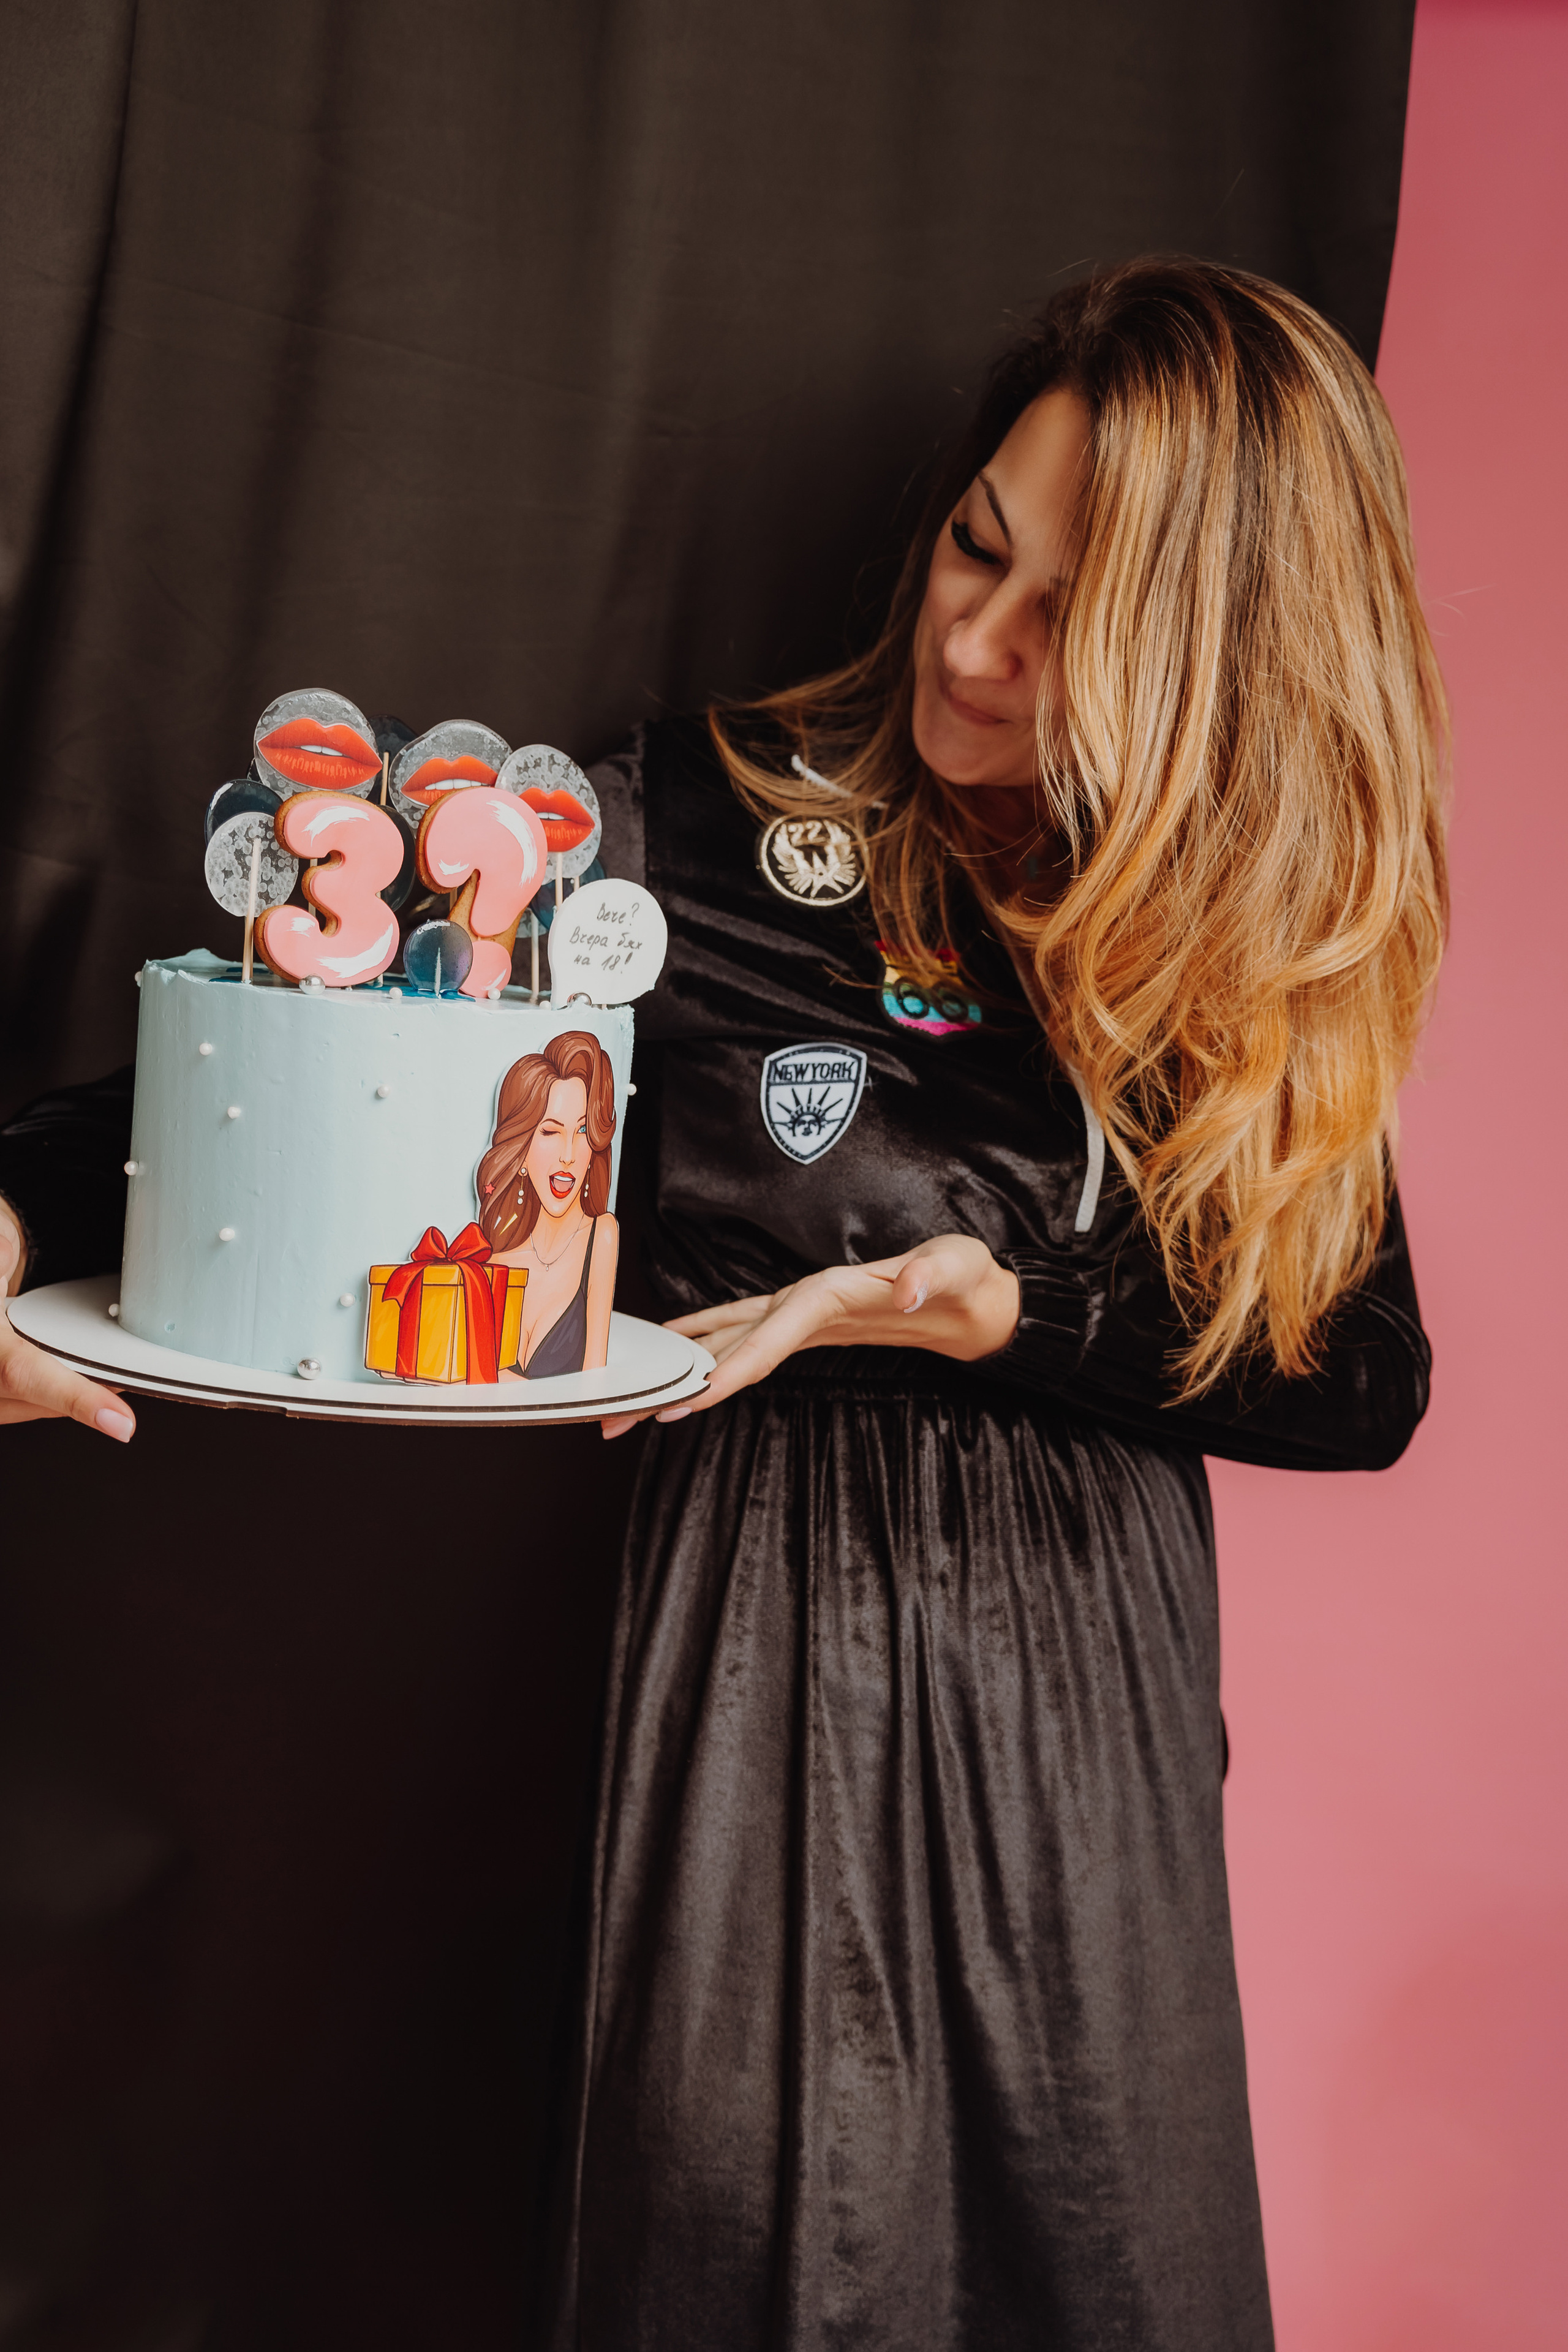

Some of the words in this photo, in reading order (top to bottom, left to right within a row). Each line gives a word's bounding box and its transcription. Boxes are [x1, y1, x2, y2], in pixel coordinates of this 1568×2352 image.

[788, 821, 826, 846] 22
[570, 926, 608, 950] Вчера
[601, 952, 633, 974] 18!
